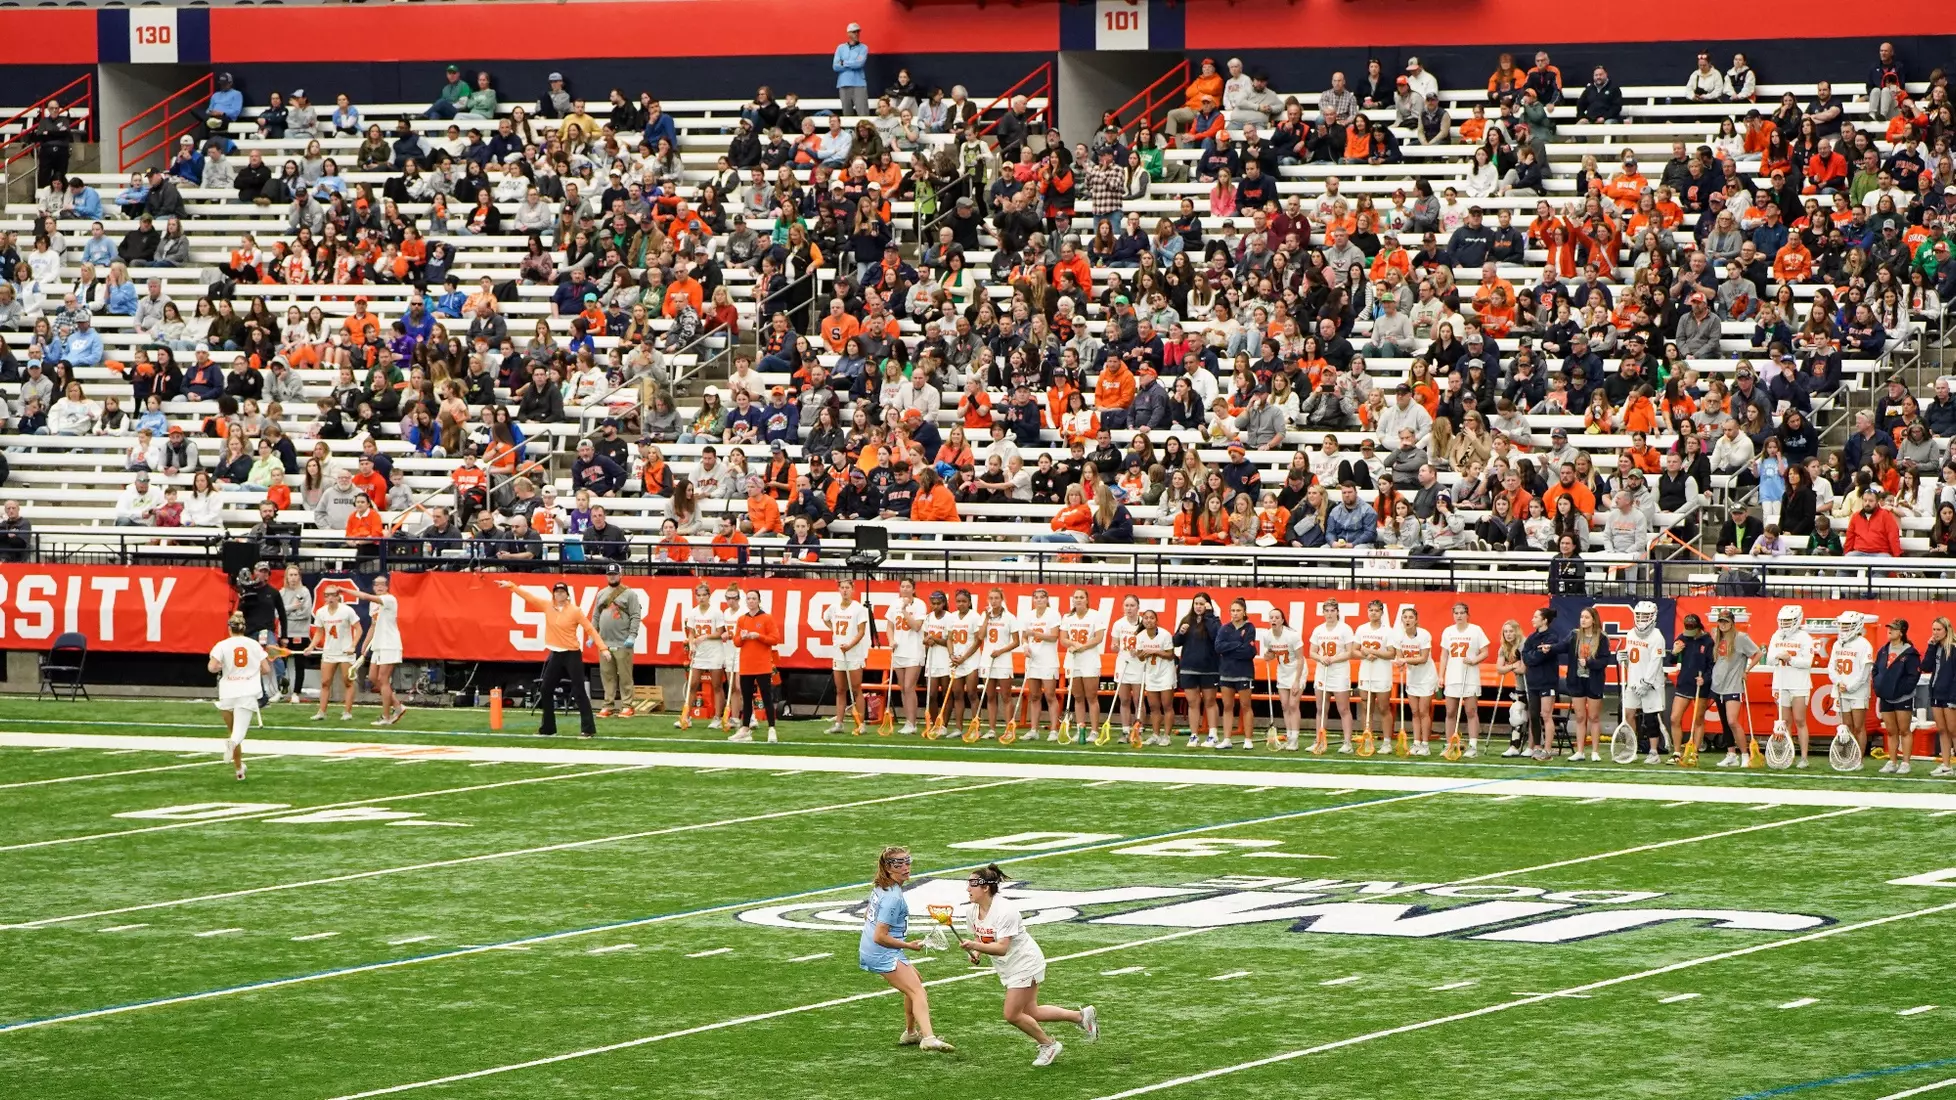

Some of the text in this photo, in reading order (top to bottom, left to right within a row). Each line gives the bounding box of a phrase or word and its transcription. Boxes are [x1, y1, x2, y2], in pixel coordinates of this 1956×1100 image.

[1104, 11, 1139, 30] 101
[135, 26, 171, 44] 130
[831, 327, 841, 340] S
[508, 583, 905, 660] SYAUSE
[834, 621, 848, 636] 17
[328, 625, 338, 639] 4
[988, 628, 998, 643] 9
[1069, 629, 1088, 645] 36
[1321, 641, 1336, 657] 18
[1450, 642, 1470, 657] 27
[232, 647, 248, 668] 8
[1834, 658, 1852, 675] 50
[1196, 874, 1676, 904] DOME
[880, 876, 1839, 945] JMA
